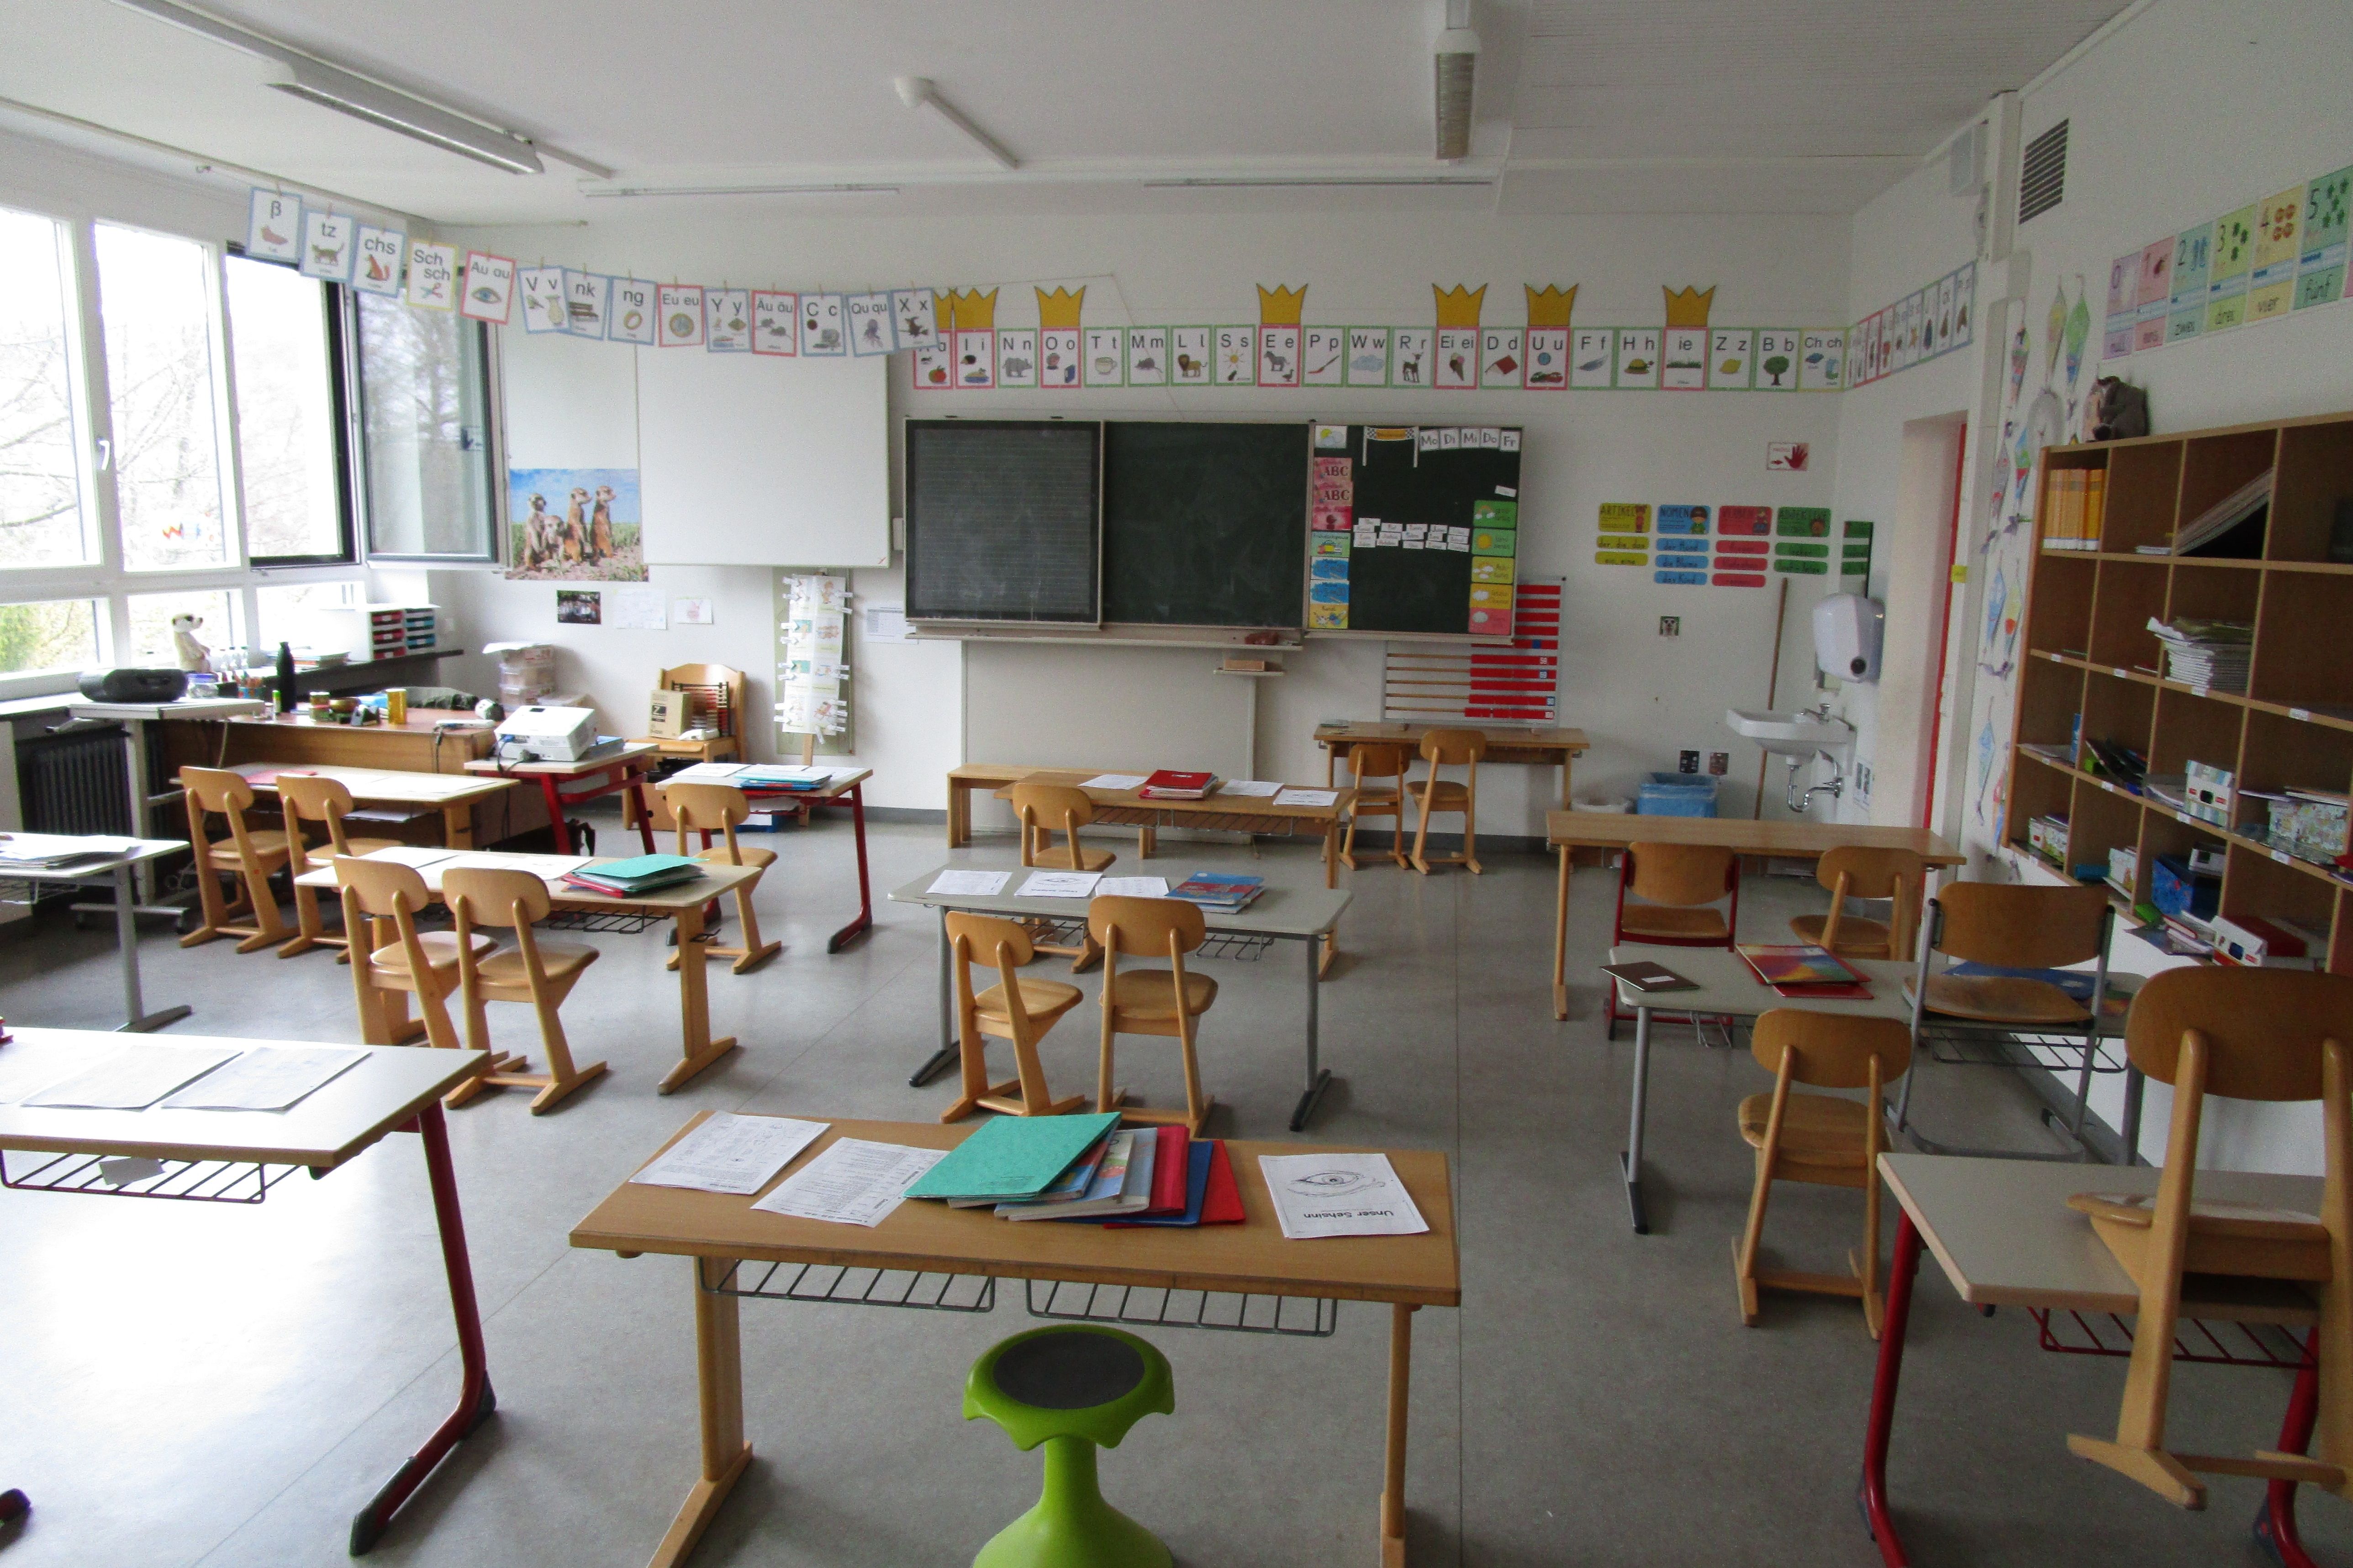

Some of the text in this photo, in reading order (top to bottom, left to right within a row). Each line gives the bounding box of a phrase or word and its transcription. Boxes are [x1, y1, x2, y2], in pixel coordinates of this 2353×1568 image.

[2308, 188, 2320, 219] 5
[322, 223, 336, 237] tz
[2217, 224, 2226, 253] 3
[364, 237, 396, 255] chs
[2178, 239, 2187, 266] 2
[413, 249, 443, 266] Sch
[424, 268, 450, 281] sch
[471, 262, 509, 280] Au au
[526, 277, 557, 291] V v
[575, 283, 595, 297] nk
[623, 291, 644, 307] ng
[662, 294, 700, 307] Eu eu
[899, 298, 928, 312] X x
[712, 299, 742, 316] Y y
[807, 302, 837, 317] C c
[851, 302, 888, 316] Qu qu
[1003, 337, 1031, 350] N n
[1045, 337, 1075, 350] O o
[1092, 336, 1101, 349] T
[1132, 336, 1164, 348] M m
[1178, 335, 1187, 347] L
[1221, 334, 1249, 348] S s
[1266, 334, 1294, 348] E e
[1310, 335, 1339, 351] P p
[1351, 335, 1385, 348] W w
[1400, 336, 1426, 349] R r
[1441, 336, 1474, 349] Ei ei
[1488, 337, 1518, 350] D d
[1533, 337, 1563, 350] U u
[1581, 336, 1591, 350] F
[1624, 337, 1654, 350] H h
[1679, 340, 1692, 350] ie
[1716, 337, 1746, 351] Z z
[1763, 337, 1794, 352] B b
[1804, 337, 1842, 348] Ch ch
[1422, 435, 1437, 445] Mo
[1445, 434, 1456, 442] Di
[1463, 432, 1477, 441] Mi
[1483, 433, 1497, 443] Do
[1504, 434, 1515, 444] Fr
[1324, 466, 1349, 476] ABC
[1324, 490, 1350, 500] ABC
[1600, 505, 1635, 516] ARTIKEL
[1660, 507, 1689, 517] NOMEN
[1598, 537, 1610, 548] der
